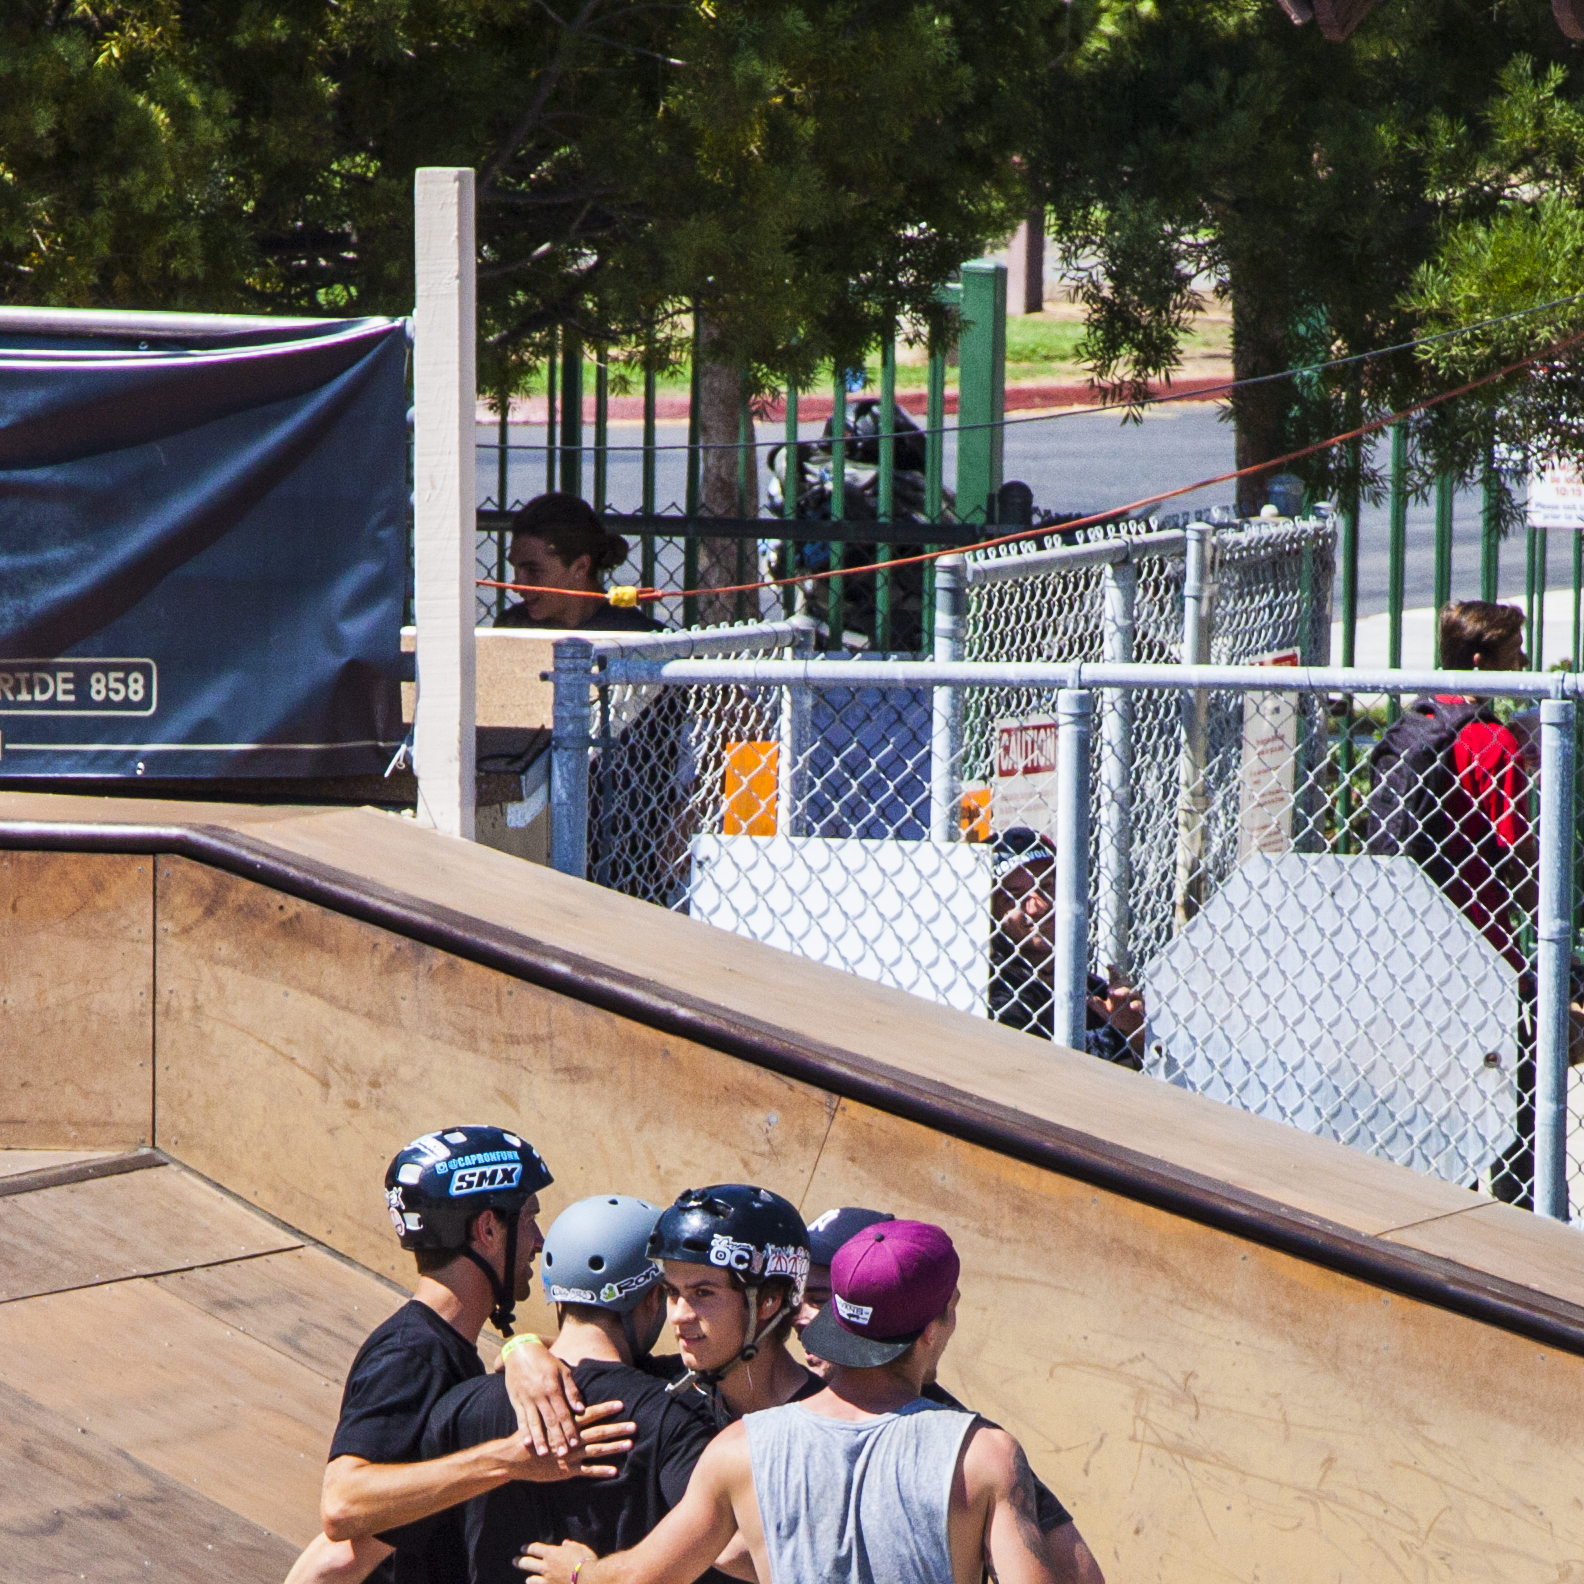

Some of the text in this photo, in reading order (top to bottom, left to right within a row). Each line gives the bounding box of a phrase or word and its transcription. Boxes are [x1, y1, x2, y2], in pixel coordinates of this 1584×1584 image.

[89, 671, 145, 702] 858
[999, 727, 1057, 771] CAUTION
[454, 1166, 518, 1191] SMX
